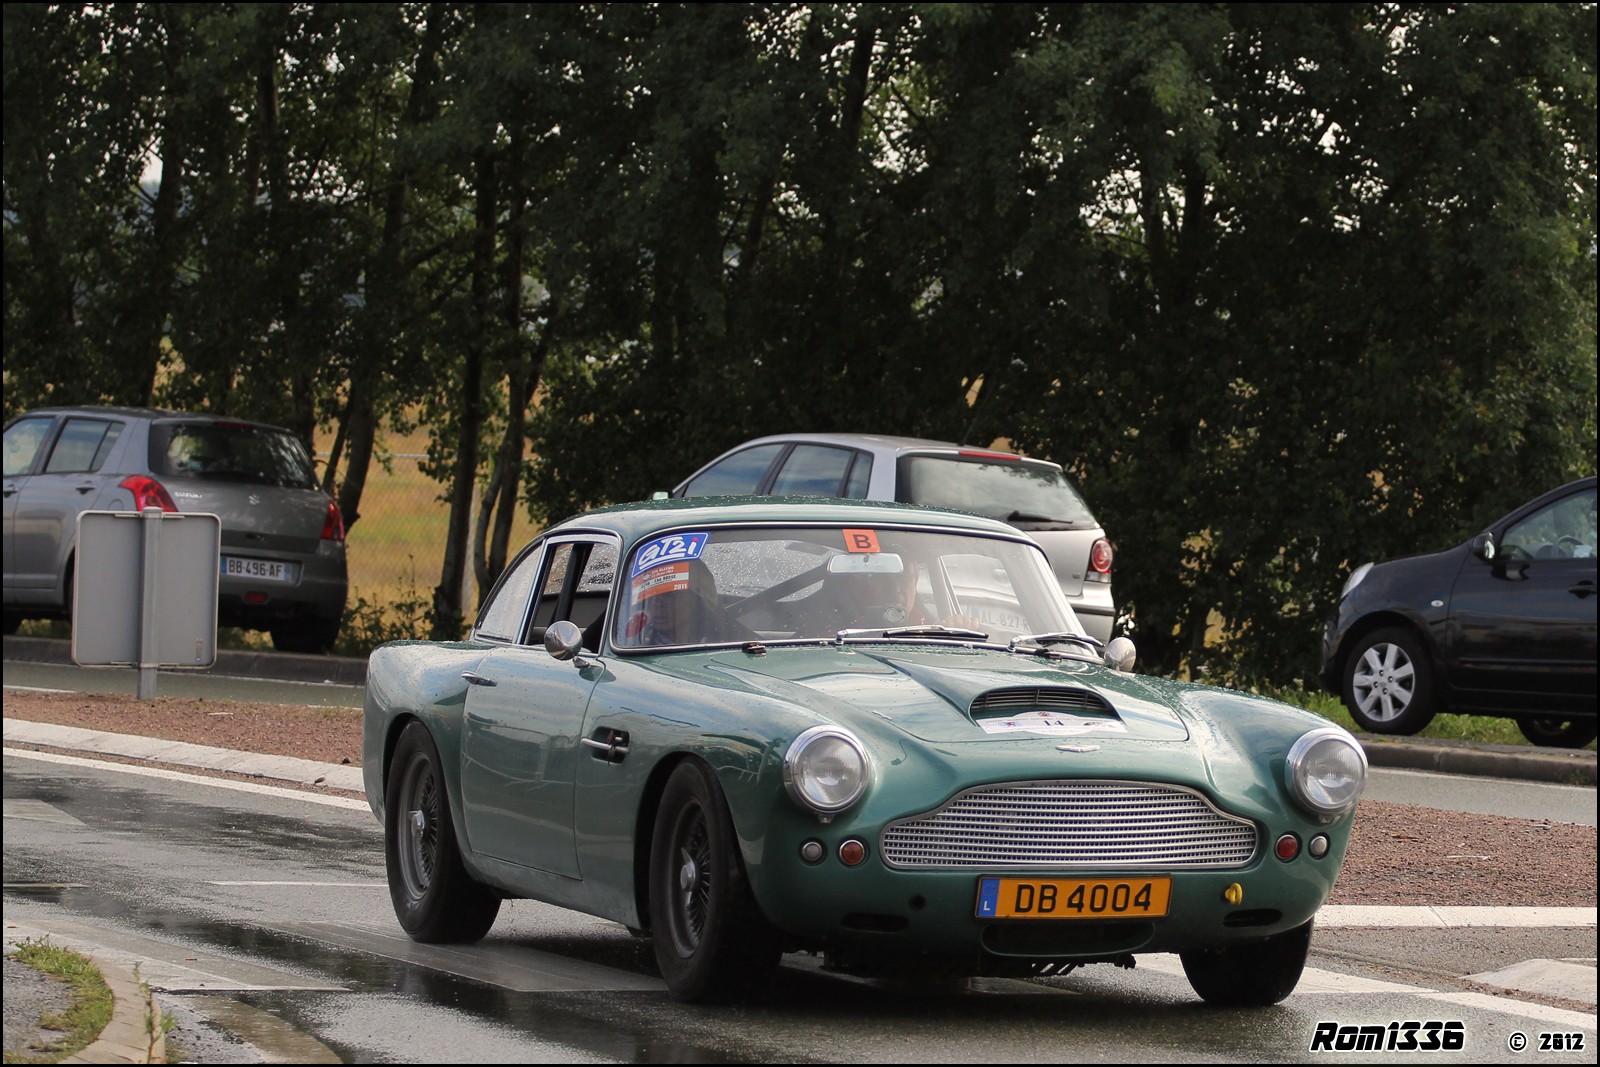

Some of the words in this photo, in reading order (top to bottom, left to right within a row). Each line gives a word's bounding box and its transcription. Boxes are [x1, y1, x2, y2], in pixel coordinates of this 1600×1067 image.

[853, 534, 872, 549] B
[1014, 884, 1058, 913] DB
[1067, 882, 1152, 913] 4004
[983, 901, 990, 910] L
